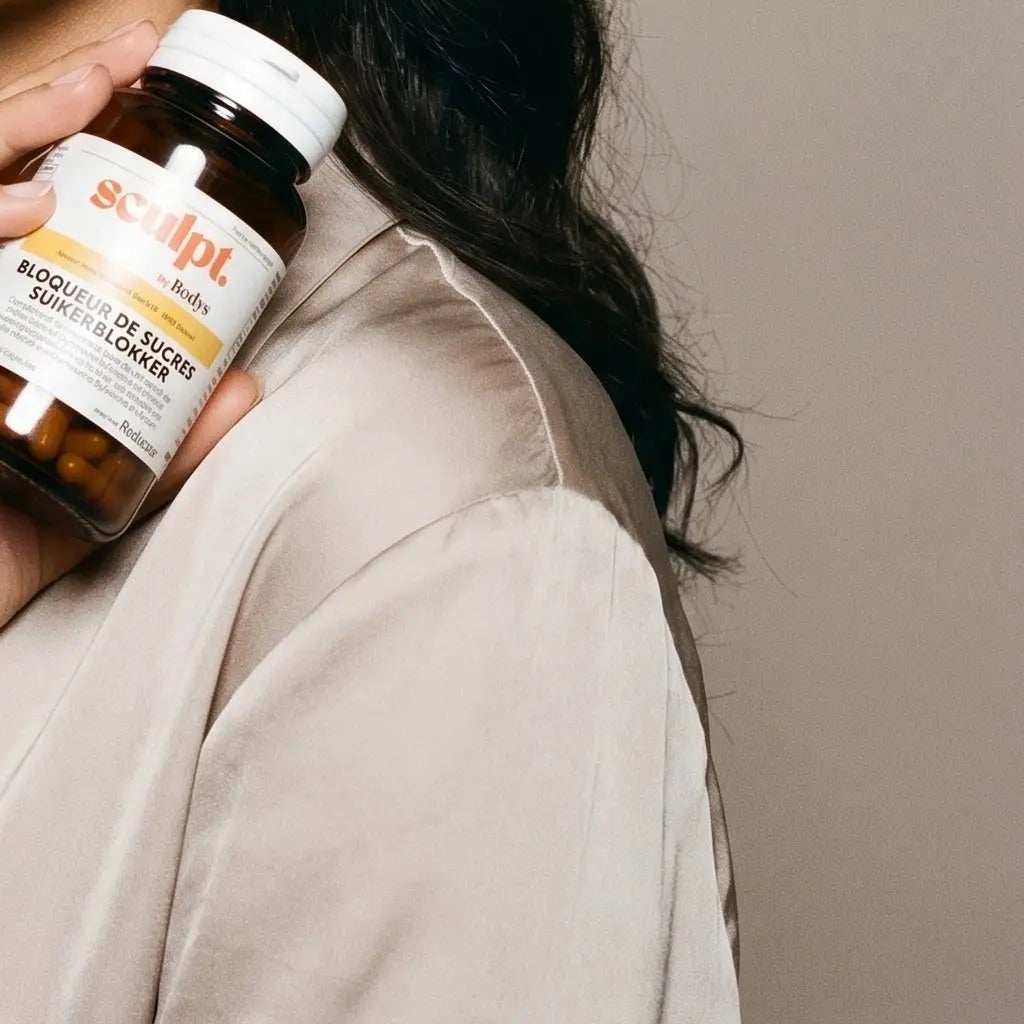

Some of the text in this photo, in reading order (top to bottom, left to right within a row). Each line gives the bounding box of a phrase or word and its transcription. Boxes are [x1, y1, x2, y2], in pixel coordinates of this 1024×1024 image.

[89, 179, 234, 287] sculpt.
[16, 259, 112, 321] BLOQUEUR
[113, 312, 141, 337] DE
[140, 331, 197, 381] SUCRES
[28, 286, 171, 383] SUIKERBLOKKER
[170, 278, 211, 316] Bodys
